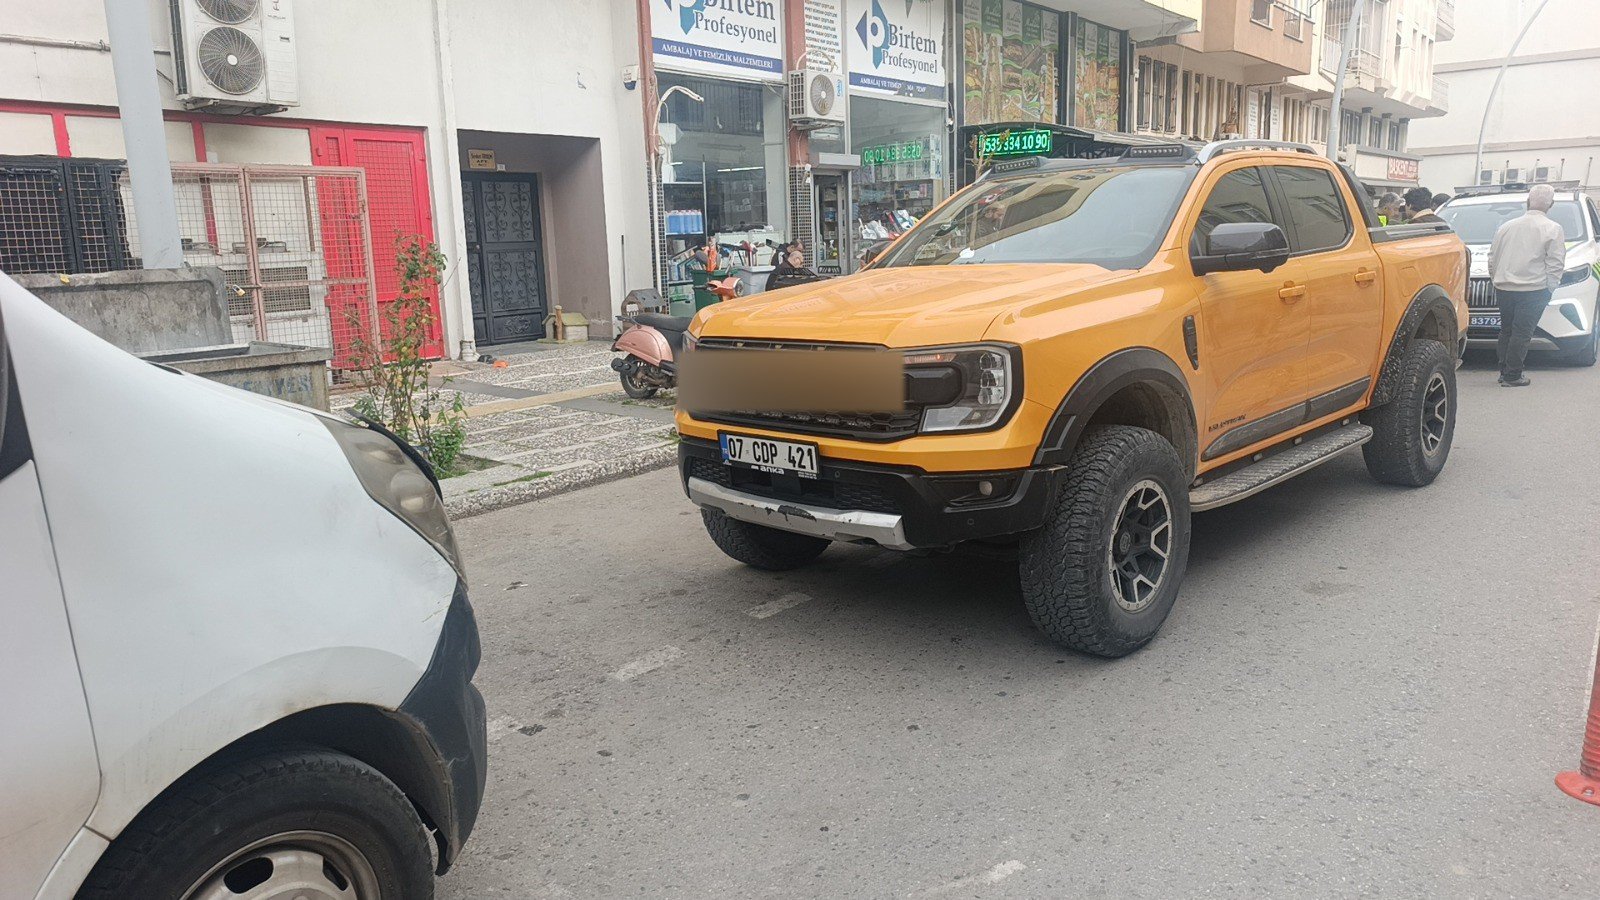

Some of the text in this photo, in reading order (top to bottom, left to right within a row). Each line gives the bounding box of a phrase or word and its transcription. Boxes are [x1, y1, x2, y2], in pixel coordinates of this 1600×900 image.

[695, 11, 777, 44] Profesyonel
[888, 23, 937, 54] Birtem
[662, 44, 773, 69] AMBALAJ VE TEMİZLİK MALZEMELERİ
[881, 50, 938, 74] Profesyonel
[1022, 134, 1034, 149] 10
[1035, 133, 1048, 149] 90
[722, 447, 729, 455] TR
[728, 437, 814, 470] 07 CDP 421
[760, 466, 785, 475] anka
